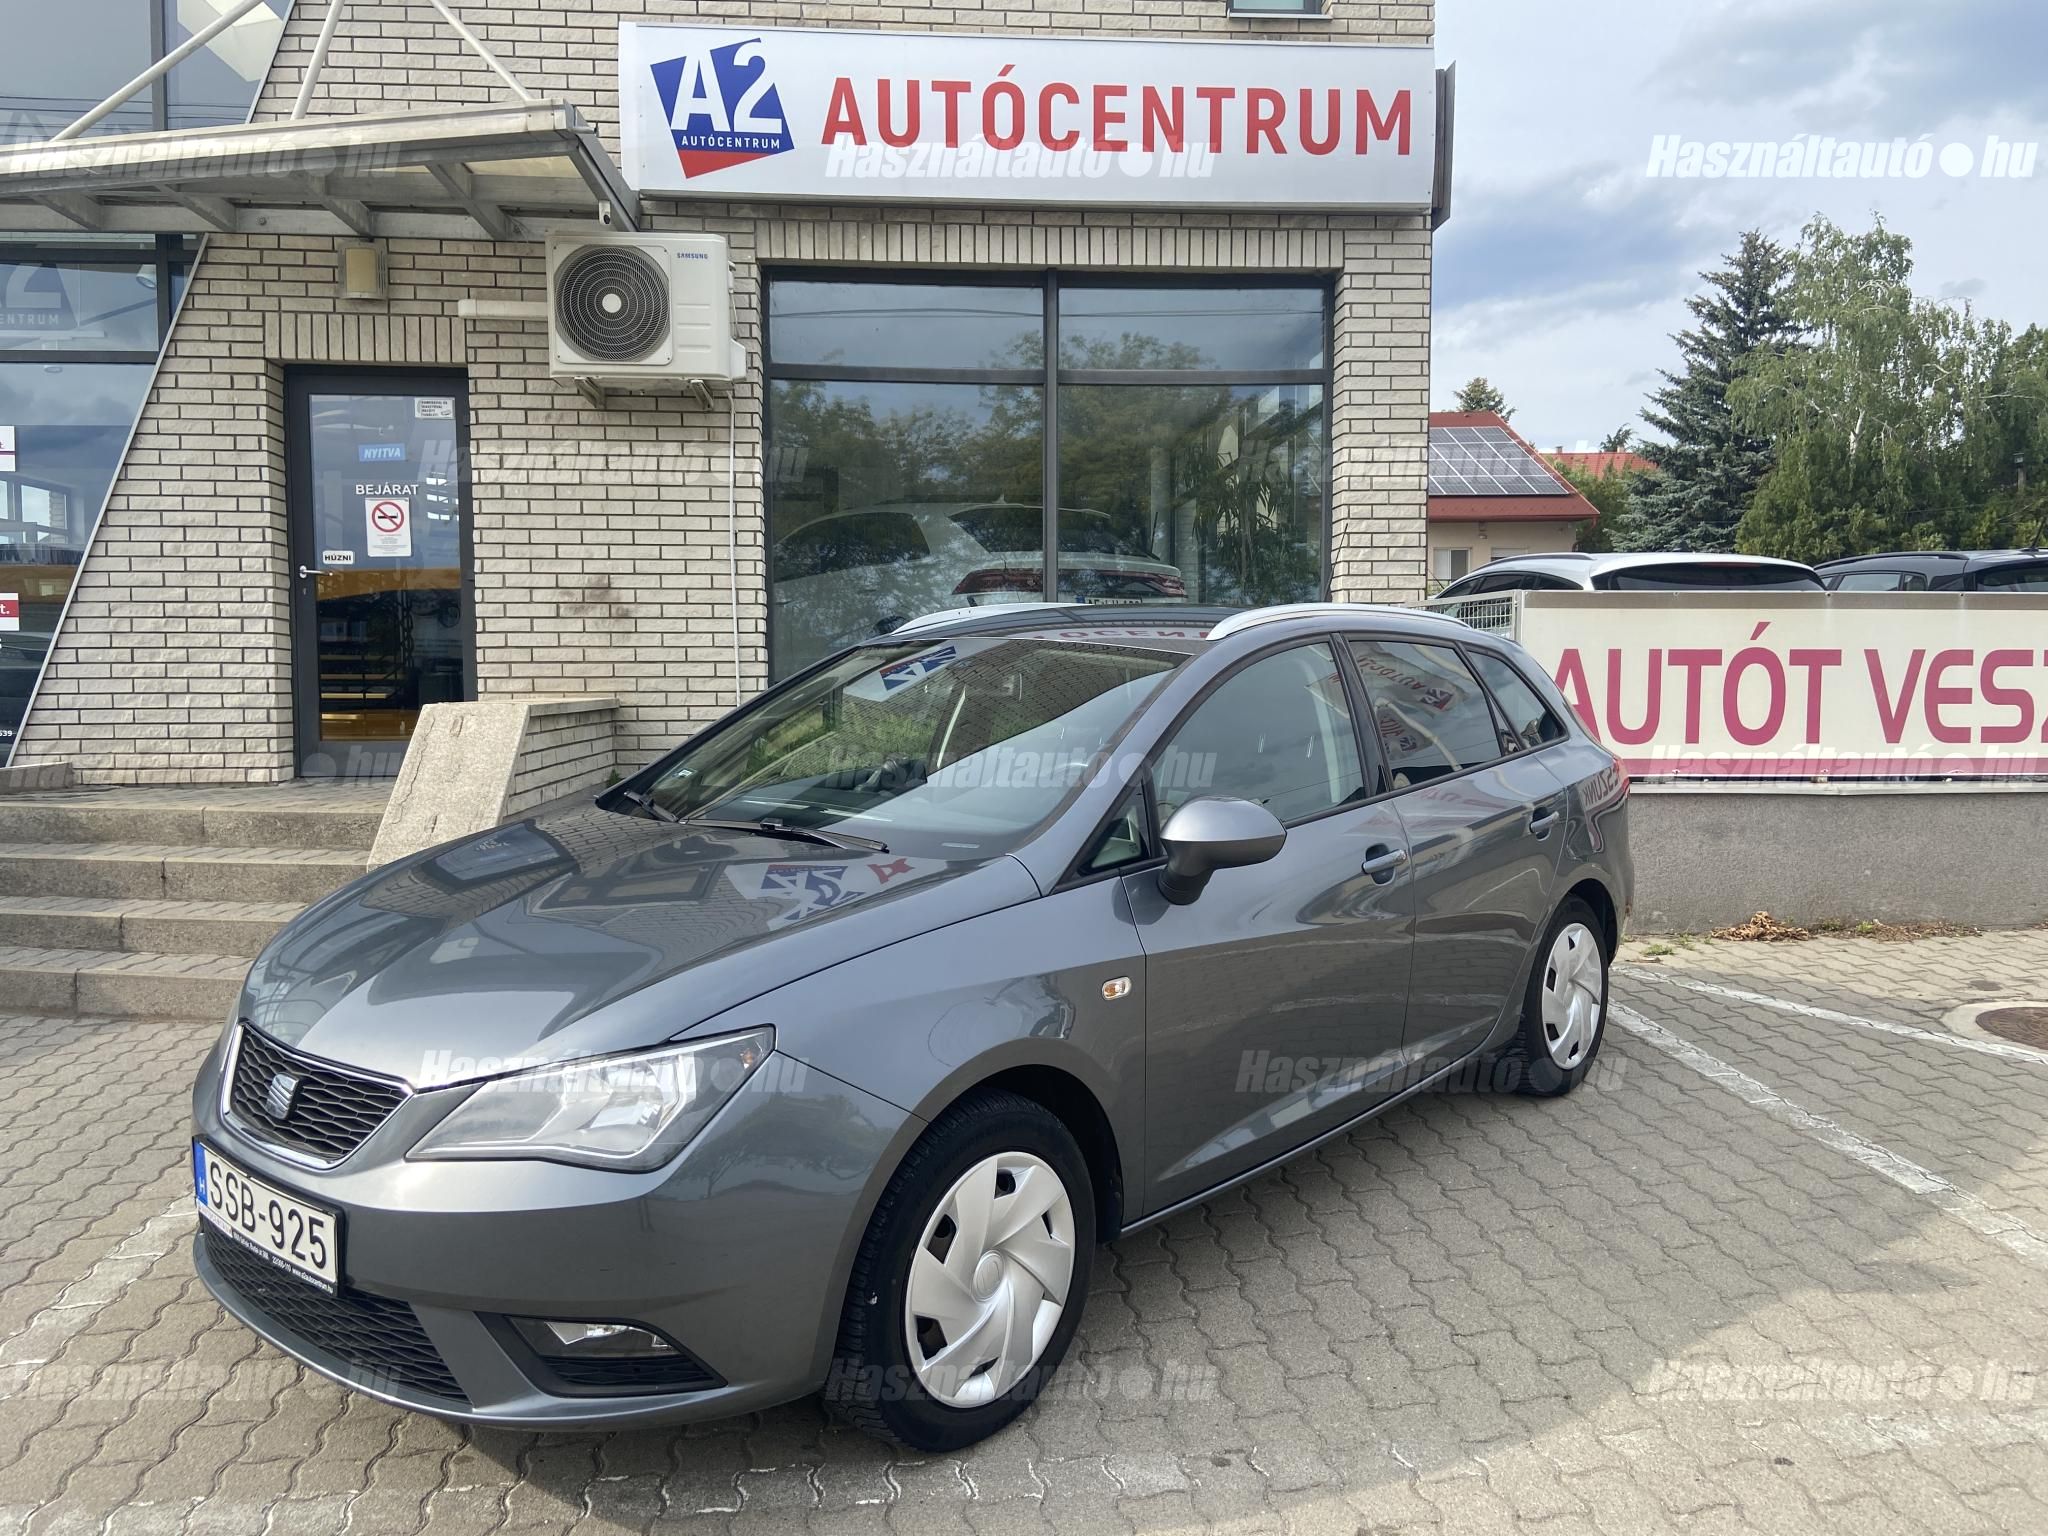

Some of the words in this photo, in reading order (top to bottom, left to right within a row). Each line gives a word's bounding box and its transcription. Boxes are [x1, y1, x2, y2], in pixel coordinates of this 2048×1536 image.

[671, 39, 782, 133] A2
[822, 64, 1411, 156] AUTÓCENTRUM
[681, 133, 781, 151] AUTÓCENTRUM
[677, 252, 709, 260] SAMSUNG
[364, 447, 401, 459] NYITVA
[355, 482, 419, 495] BEJÁRAT
[324, 553, 352, 562] HÚZNI
[1554, 621, 1842, 746] AUTÓT
[1865, 648, 2048, 744] VES
[198, 1177, 205, 1194] H
[210, 1161, 327, 1270] SSB-925
